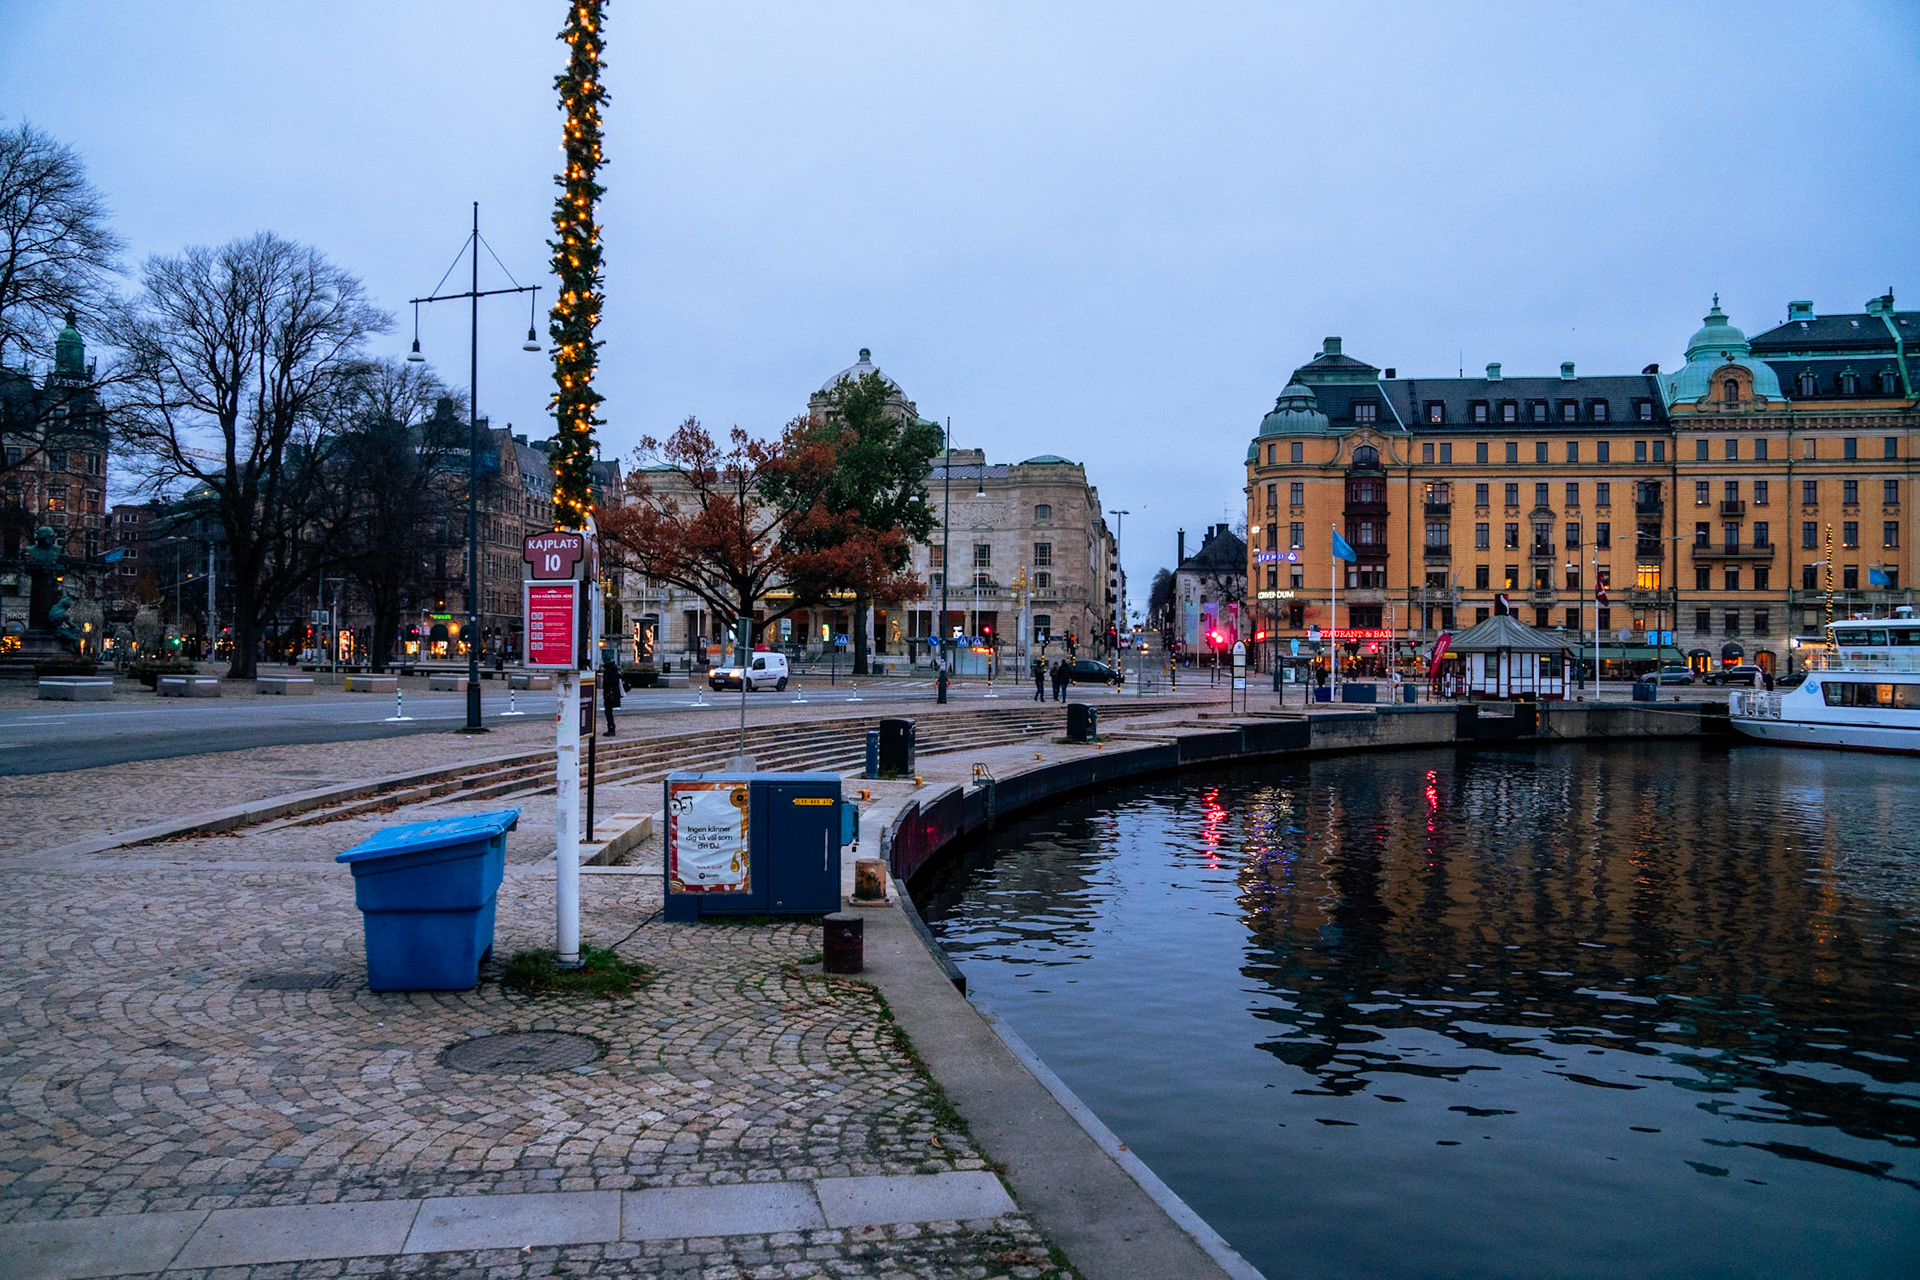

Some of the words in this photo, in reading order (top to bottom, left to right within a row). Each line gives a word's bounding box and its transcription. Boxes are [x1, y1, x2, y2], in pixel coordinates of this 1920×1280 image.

[528, 539, 578, 551] KAJPLATS
[545, 554, 561, 571] 10
[1306, 630, 1363, 638] STAURANT
[1374, 630, 1392, 638] BAR
[687, 826, 707, 834] Ingen
[708, 825, 731, 833] känner
[685, 834, 697, 842] dig
